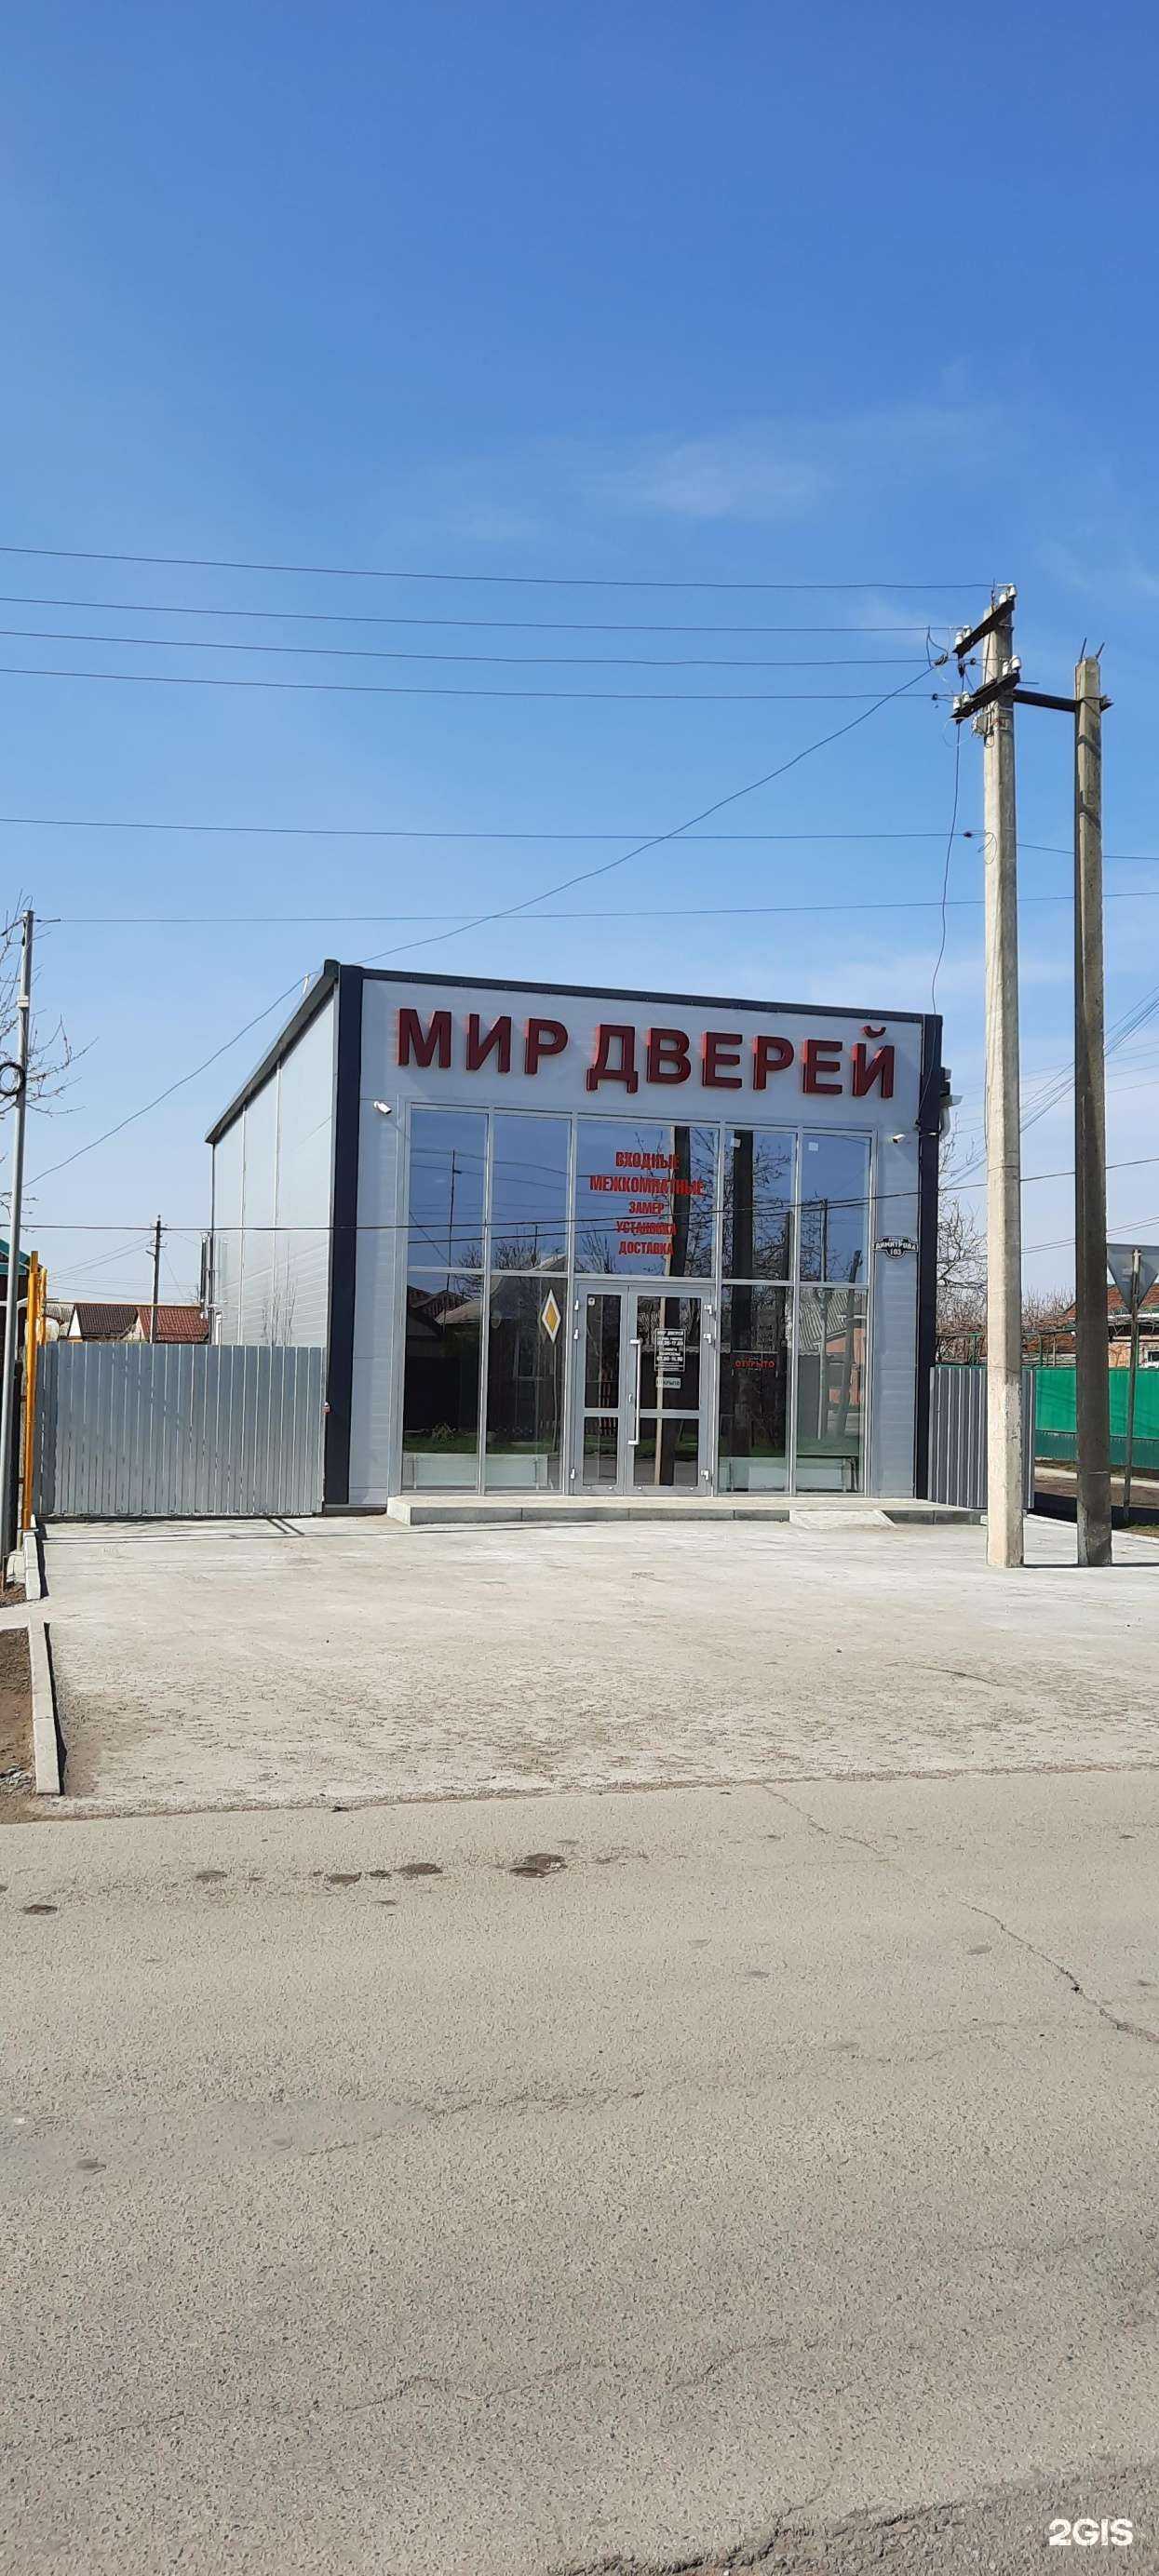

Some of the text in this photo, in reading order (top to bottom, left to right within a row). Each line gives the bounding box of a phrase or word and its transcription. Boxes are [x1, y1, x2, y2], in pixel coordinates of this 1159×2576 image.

[398, 1008, 895, 1098] МИР ДВЕРЕЙ
[615, 1152, 681, 1170] ВХОДНЫЕ
[590, 1175, 704, 1196] МЕЖКОМНАТНЫЕ
[628, 1201, 665, 1214] ЗАМЕР
[615, 1221, 677, 1236] УСТАНОВКА
[618, 1241, 674, 1255] ДОСТАВКА
